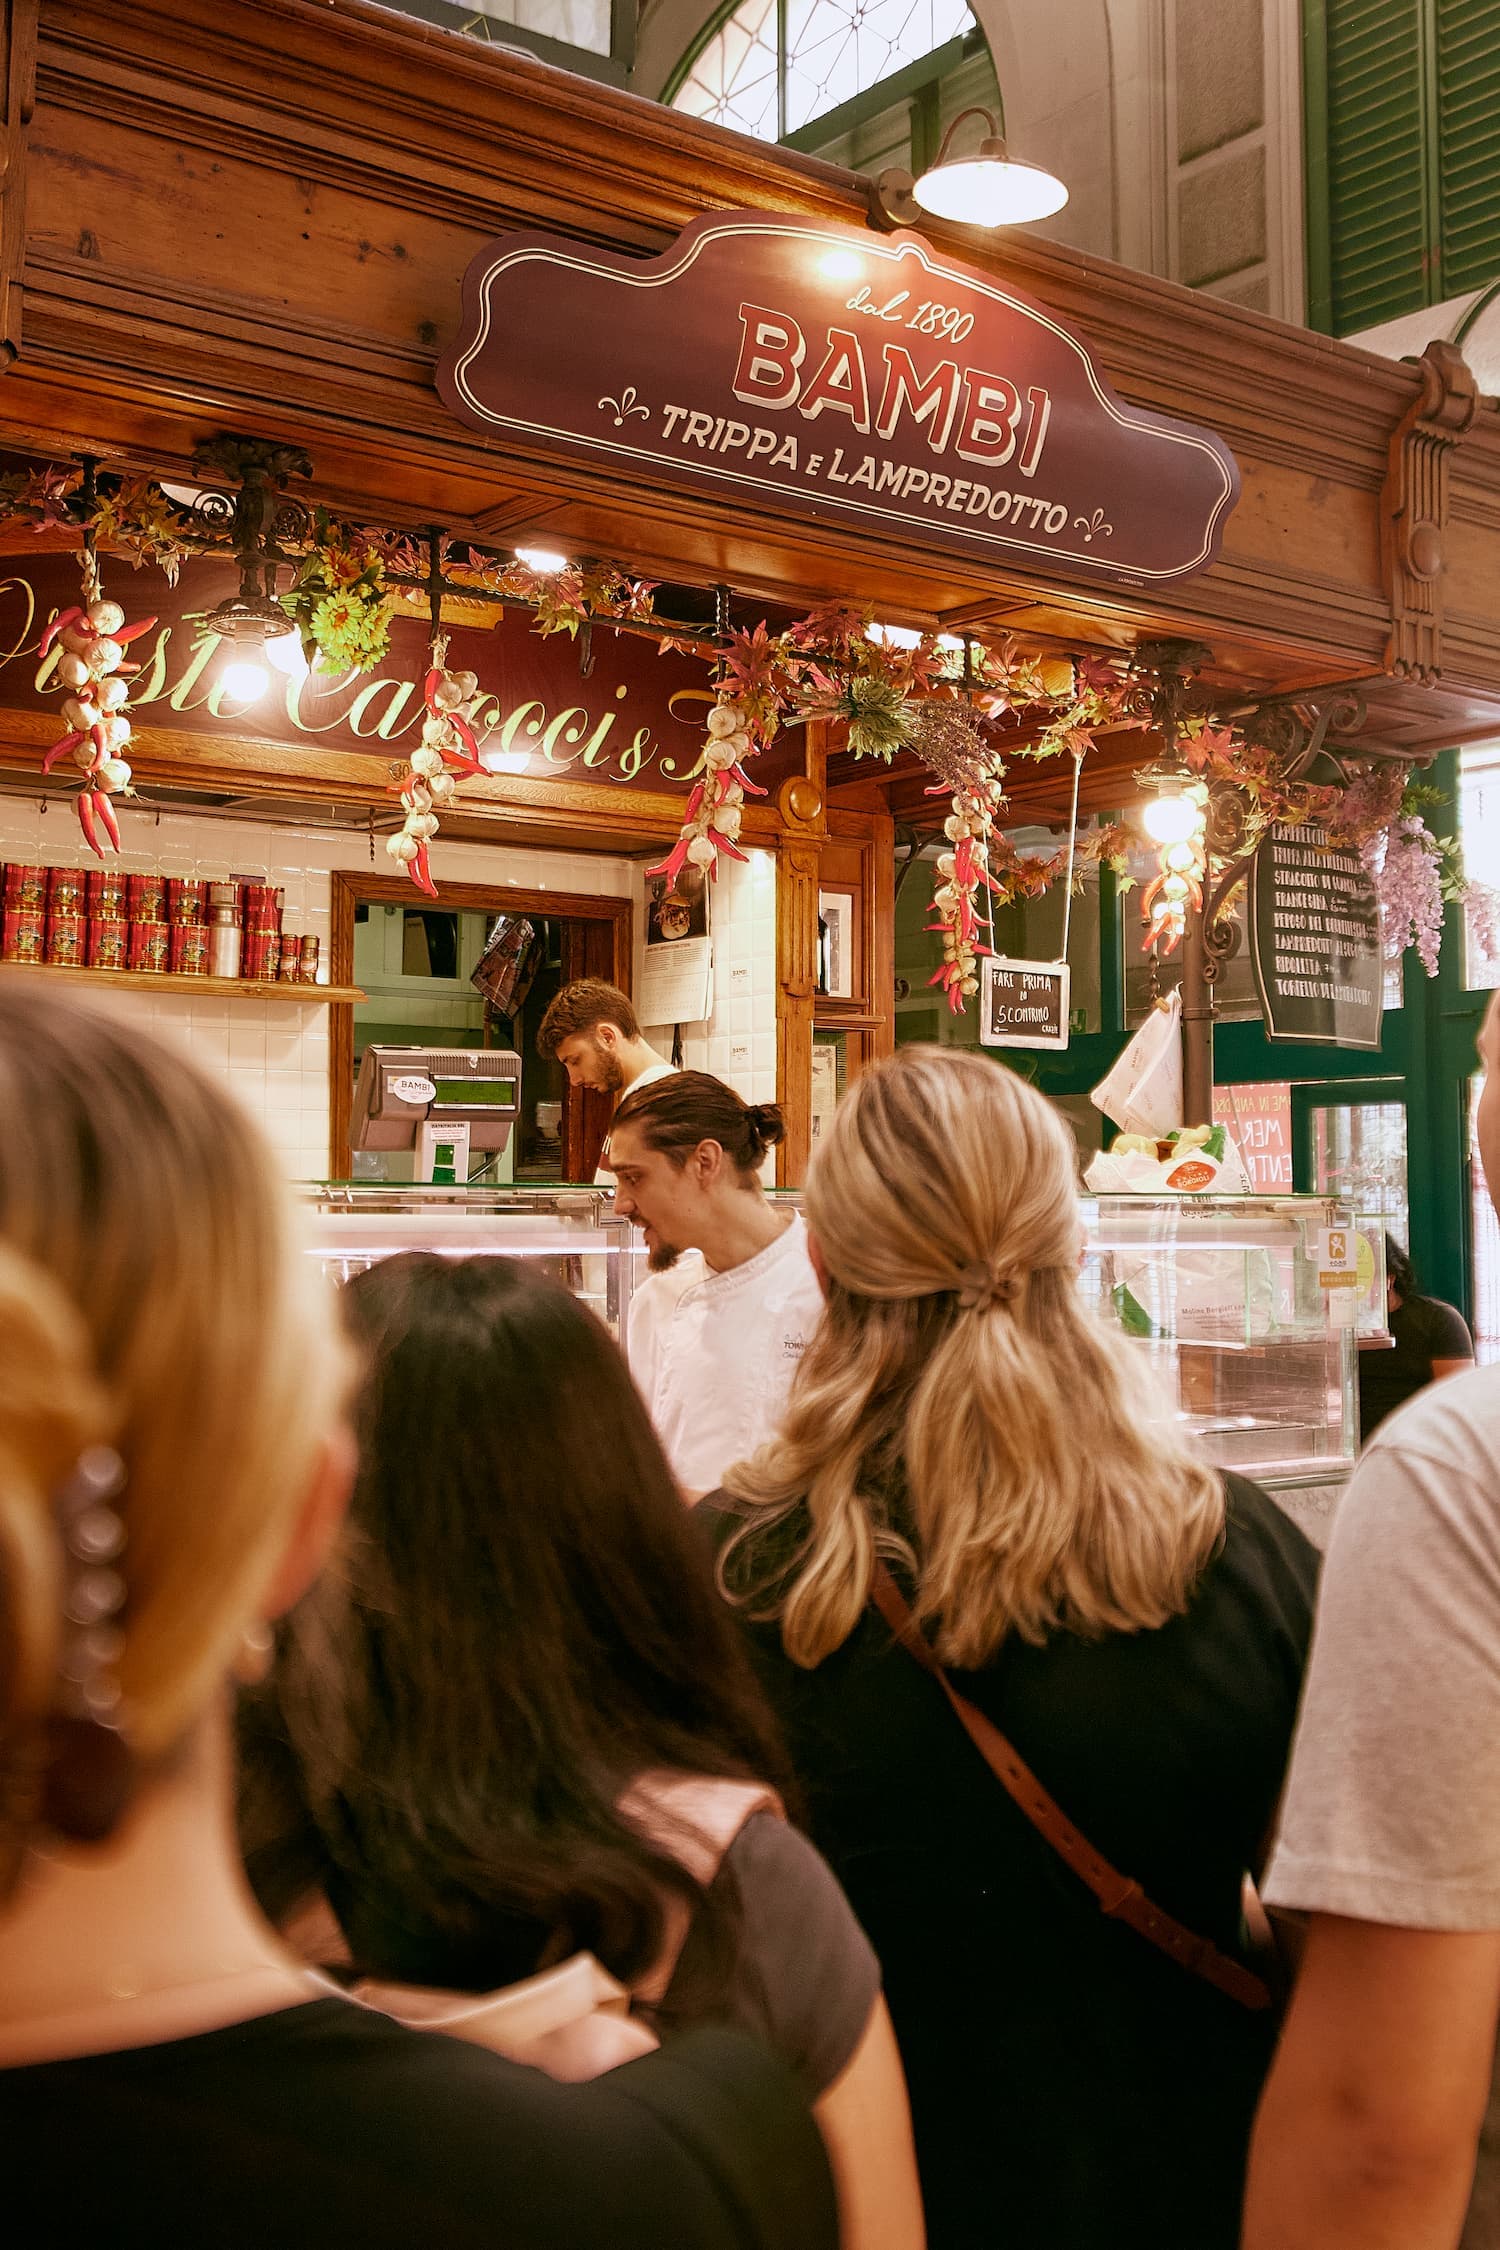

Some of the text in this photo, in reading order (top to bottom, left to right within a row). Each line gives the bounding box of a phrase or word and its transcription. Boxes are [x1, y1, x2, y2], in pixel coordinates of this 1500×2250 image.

[846, 286, 976, 345] dal 1890
[732, 302, 1052, 478] BAMBI
[660, 404, 1069, 535] TRIPPA E LAMPREDOTTO
[284, 652, 626, 769] Caocci
[608, 727, 660, 782] &
[1275, 891, 1328, 911] FRANCESINA
[1274, 912, 1306, 929] PEPOSO
[1308, 915, 1323, 932] DEL
[1275, 956, 1322, 976] RIBOLLITA
[992, 971, 1052, 992] FARE PRIMA
[1275, 978, 1320, 998] TORTELLO
[1020, 991, 1028, 1001] LO
[997, 1005, 1050, 1024] SCONTRINO
[401, 1080, 431, 1091] BAMBI
